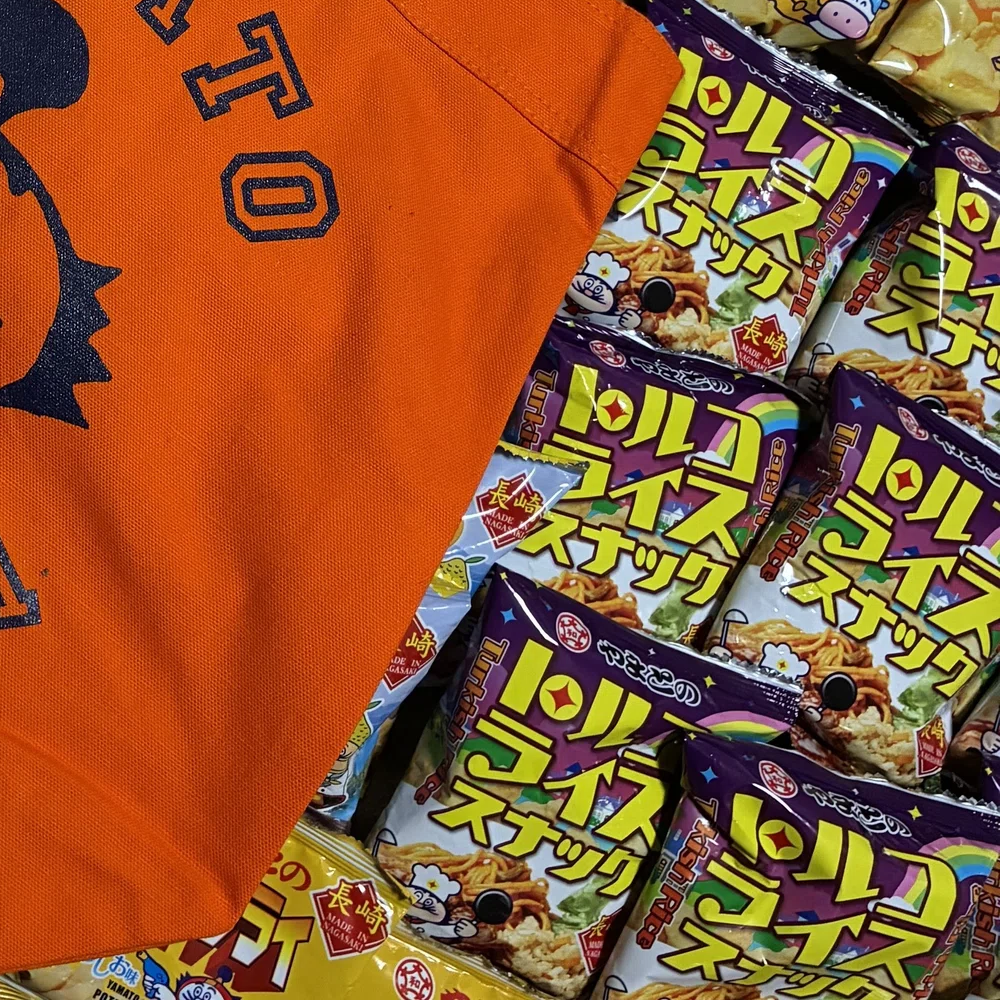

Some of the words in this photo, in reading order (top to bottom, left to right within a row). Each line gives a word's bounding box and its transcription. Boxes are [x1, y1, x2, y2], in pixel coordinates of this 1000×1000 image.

[615, 171, 793, 302] スナック
[641, 110, 824, 265] ライス
[829, 167, 871, 228] Rice
[558, 363, 763, 485] トルコ
[541, 432, 749, 557] ライス
[515, 508, 731, 606] スナック
[597, 638, 701, 707] やまとの
[788, 555, 980, 699] スナック
[429, 776, 643, 897] スナック
[466, 709, 666, 848] ライス
[328, 882, 388, 935] 長崎
[697, 849, 938, 991] ライス
[729, 791, 957, 932] トルコ
[322, 921, 365, 952] NAGASAKI
[327, 914, 354, 933] MADE
